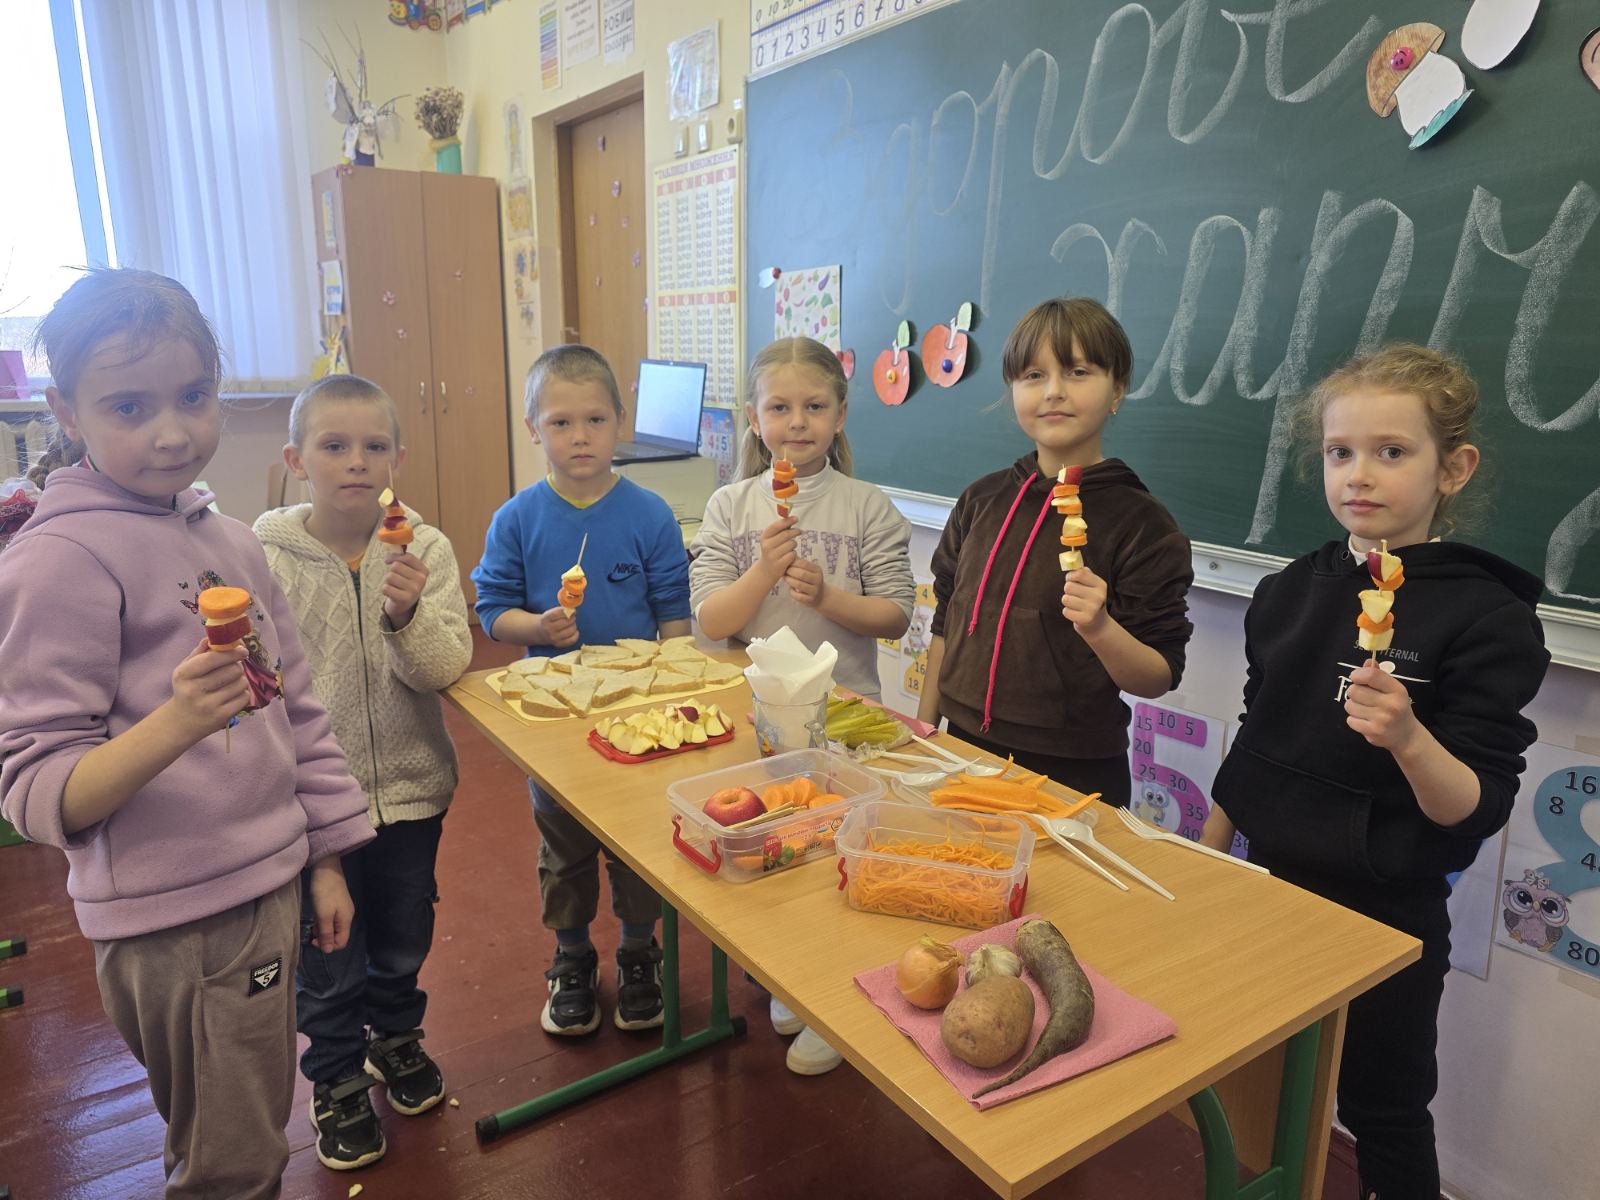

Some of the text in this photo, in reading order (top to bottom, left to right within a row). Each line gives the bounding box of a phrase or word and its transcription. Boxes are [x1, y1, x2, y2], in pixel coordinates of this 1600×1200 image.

[768, 3, 779, 16] 10
[755, 45, 764, 67] 0
[771, 38, 779, 62] 1
[784, 33, 794, 57] 2
[800, 26, 810, 50] 3
[817, 17, 826, 42] 4
[834, 9, 845, 36] 5
[854, 3, 865, 28] 6
[721, 435, 727, 451] 5
[612, 562, 641, 574] NIKE
[915, 661, 926, 675] 16
[908, 677, 920, 691] 18
[1135, 711, 1194, 736] 15 10 5
[1134, 738, 1151, 755] 20
[1138, 763, 1187, 792] 25 30
[1564, 771, 1598, 795] 16
[1185, 802, 1204, 821] 35
[1549, 796, 1564, 815] 8
[1182, 825, 1200, 842] 40
[1580, 852, 1600, 873] 4
[1567, 941, 1600, 967] 80
